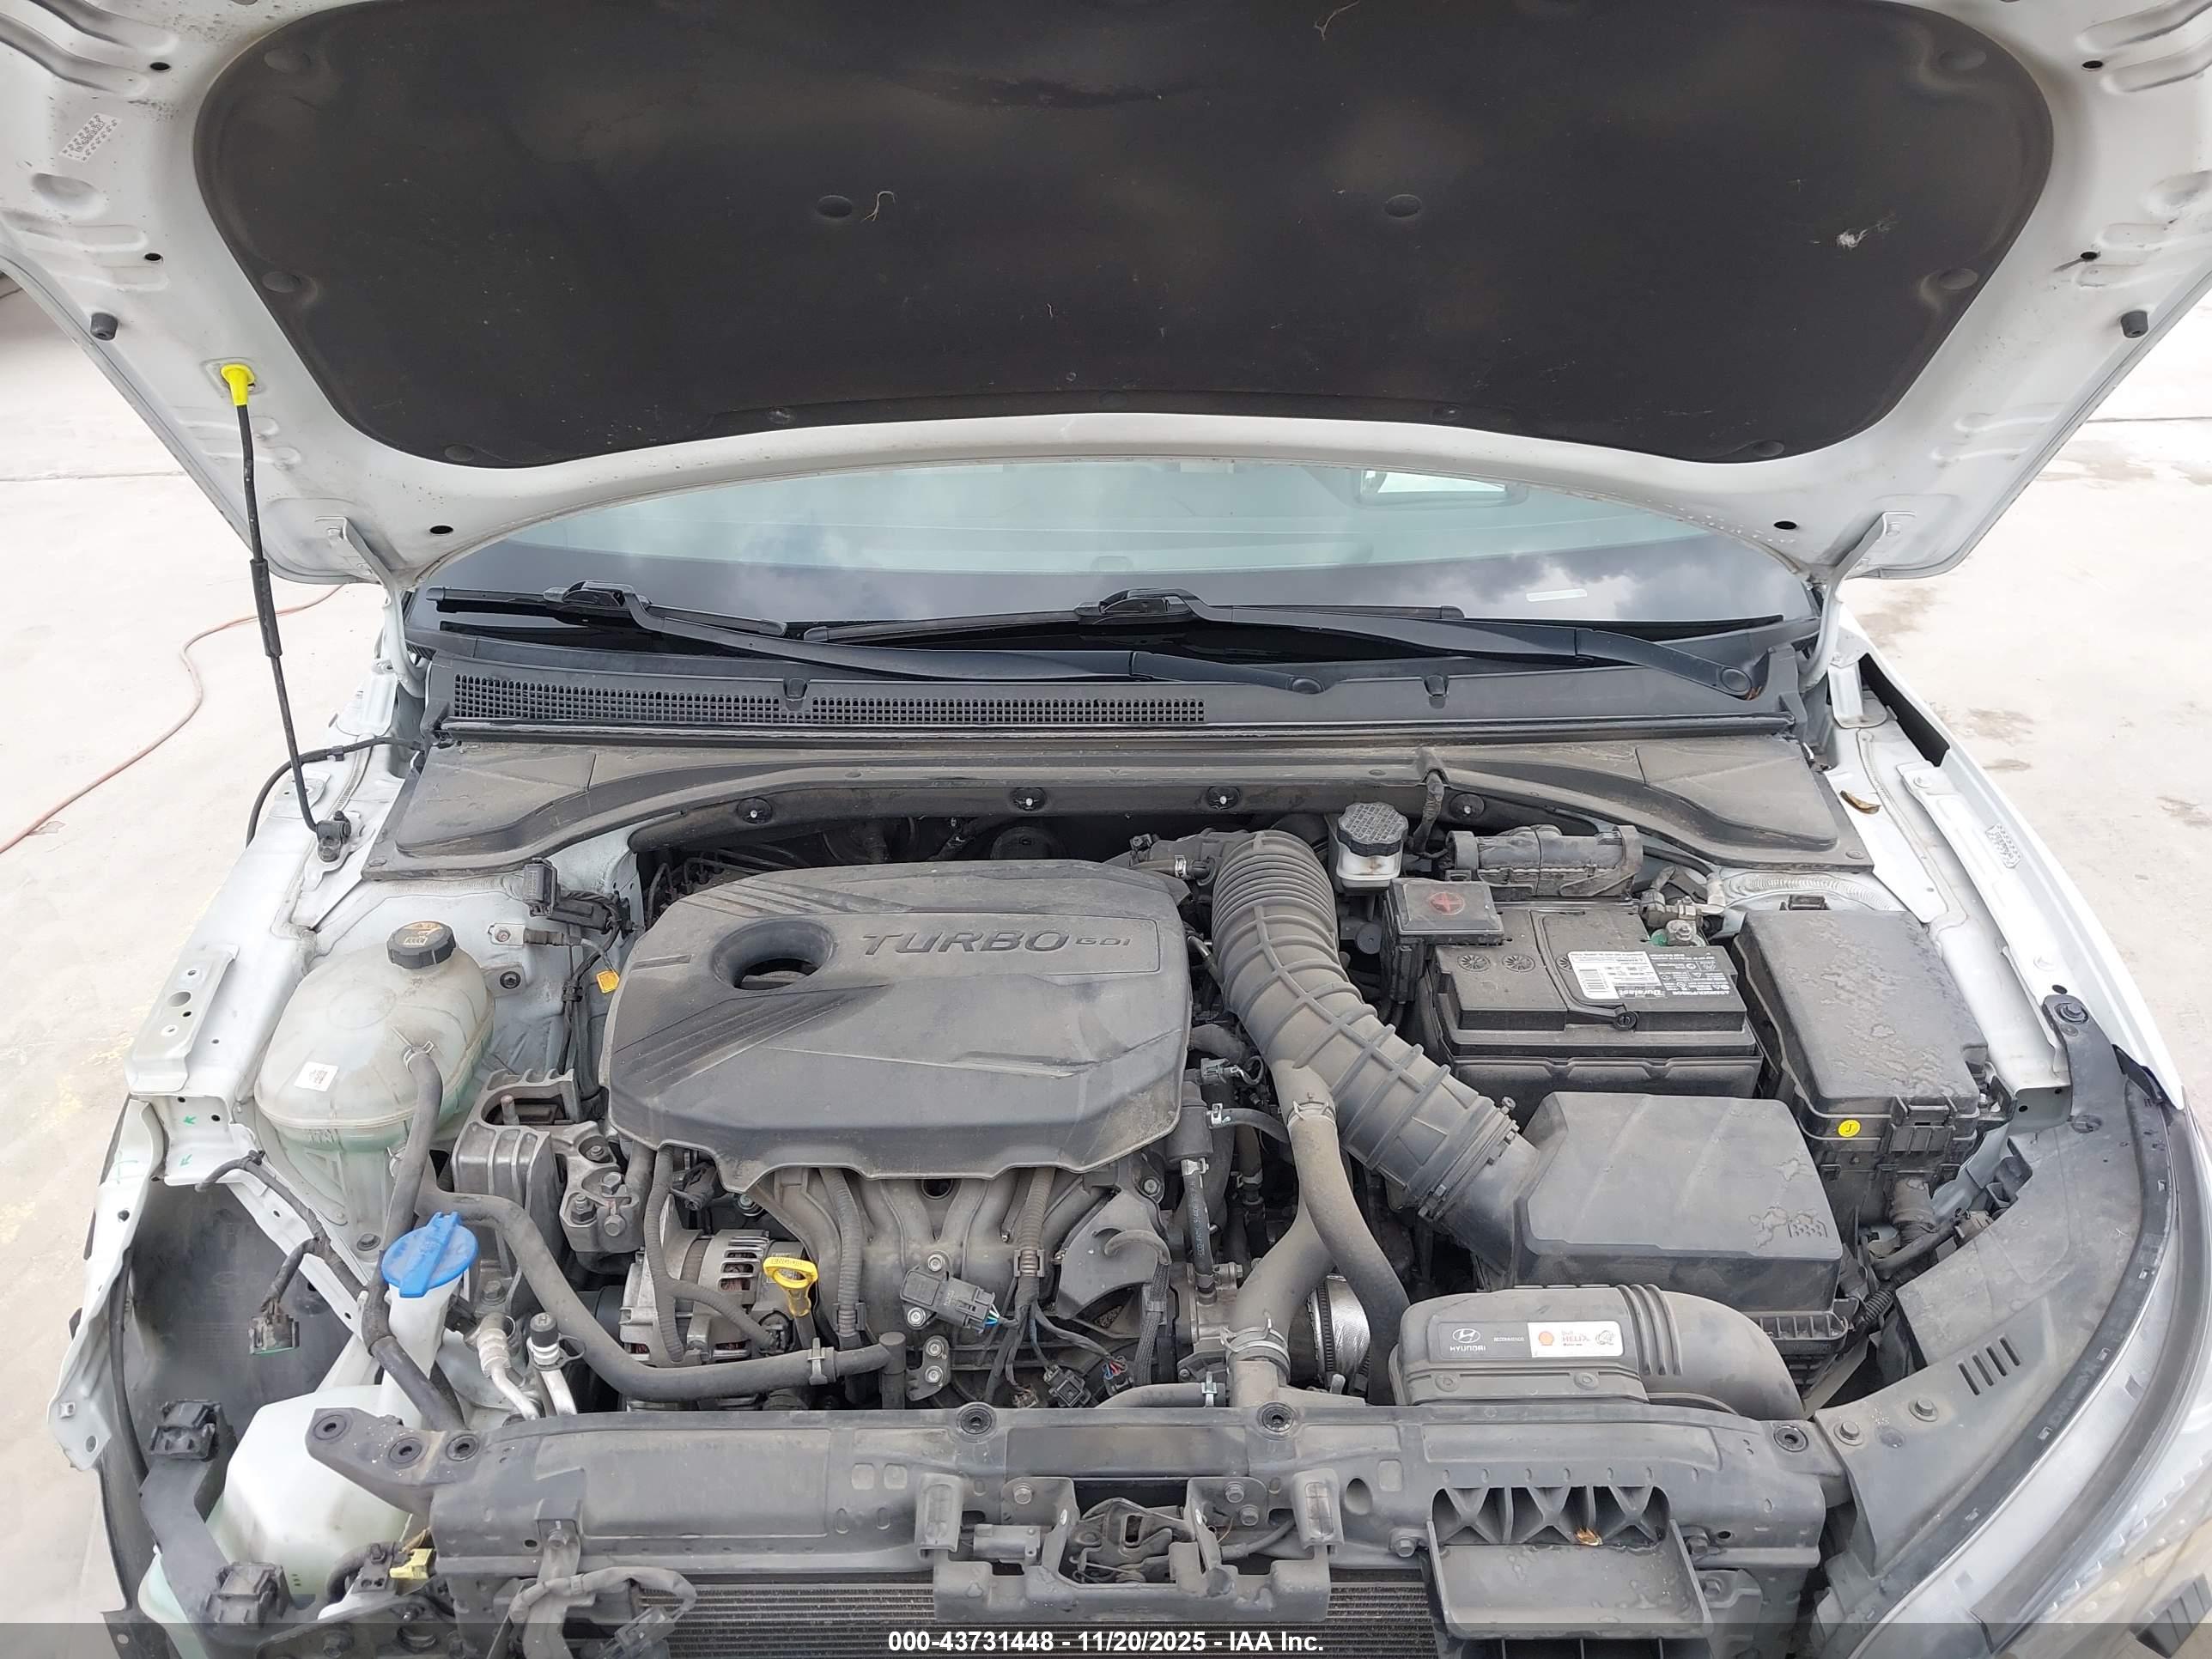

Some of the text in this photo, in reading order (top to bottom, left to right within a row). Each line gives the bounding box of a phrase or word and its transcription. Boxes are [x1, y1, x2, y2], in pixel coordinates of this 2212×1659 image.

[862, 931, 1132, 956] TURBO GDI
[1845, 1124, 1852, 1133] J
